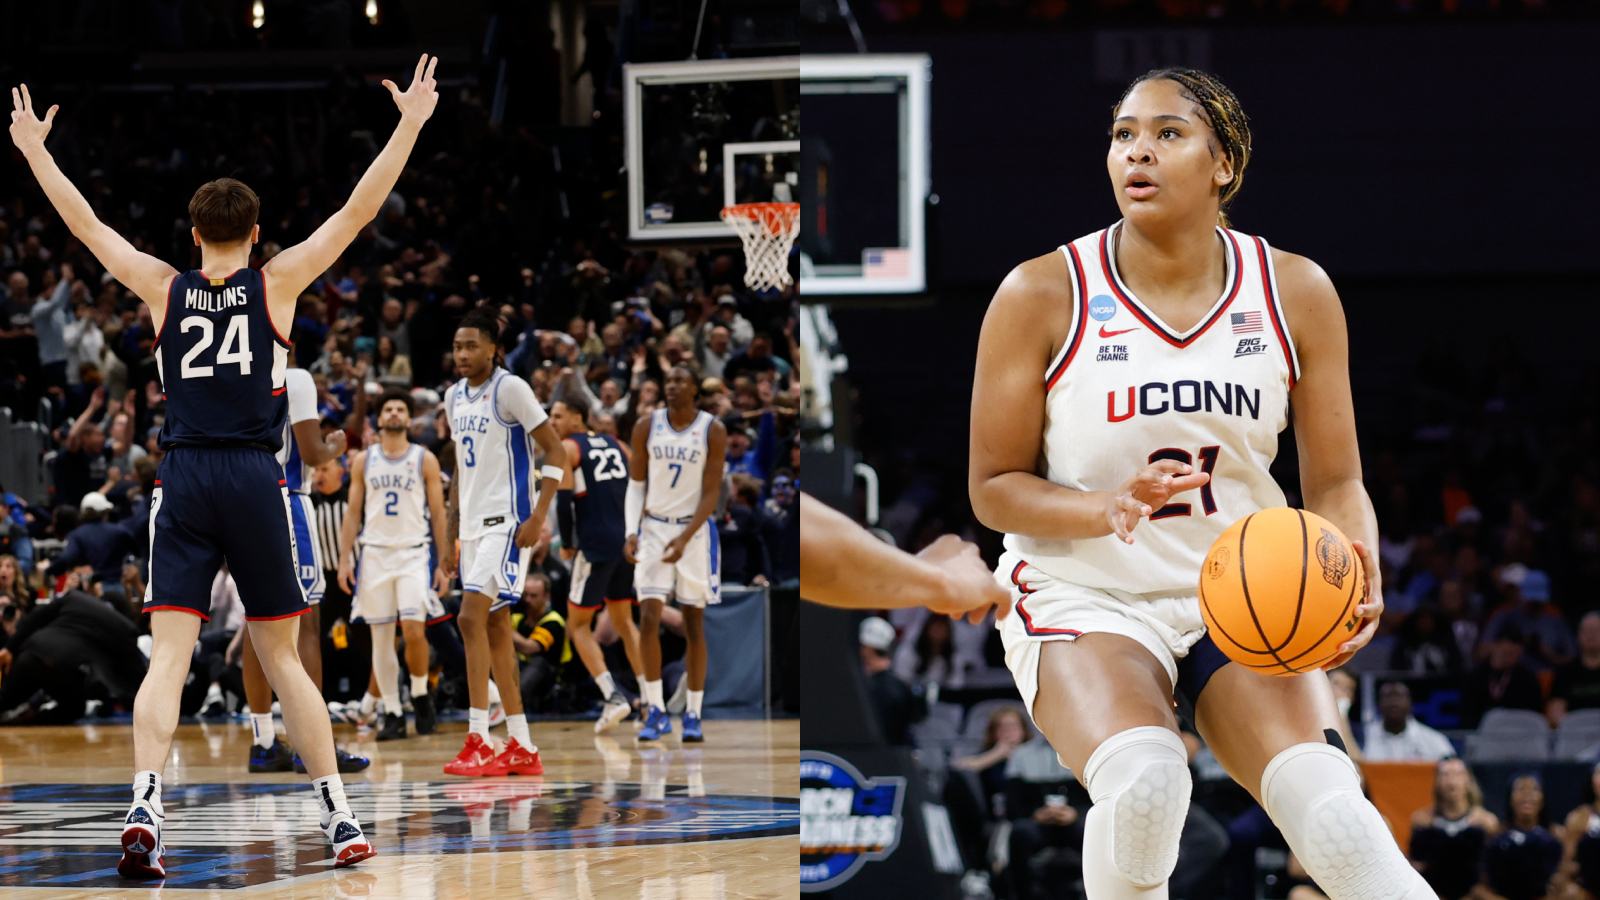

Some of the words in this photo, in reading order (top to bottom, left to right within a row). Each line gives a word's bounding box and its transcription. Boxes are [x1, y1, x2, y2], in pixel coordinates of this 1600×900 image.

[185, 286, 247, 312] MULLINS
[1092, 306, 1115, 314] NCAA
[180, 314, 253, 379] 24
[1099, 345, 1110, 354] BE
[1112, 345, 1127, 353] THE
[1235, 344, 1268, 355] EAST
[1238, 337, 1261, 347] BIG
[1096, 353, 1129, 361] CHANGE
[1107, 380, 1260, 422] UCONN
[454, 415, 489, 434] DUKE
[462, 436, 475, 467] 3
[653, 446, 700, 464] DUKE
[588, 448, 627, 482] 23
[370, 474, 416, 491] DUKE
[669, 463, 682, 488] 7
[385, 491, 398, 516] 2
[301, 565, 315, 580] D
